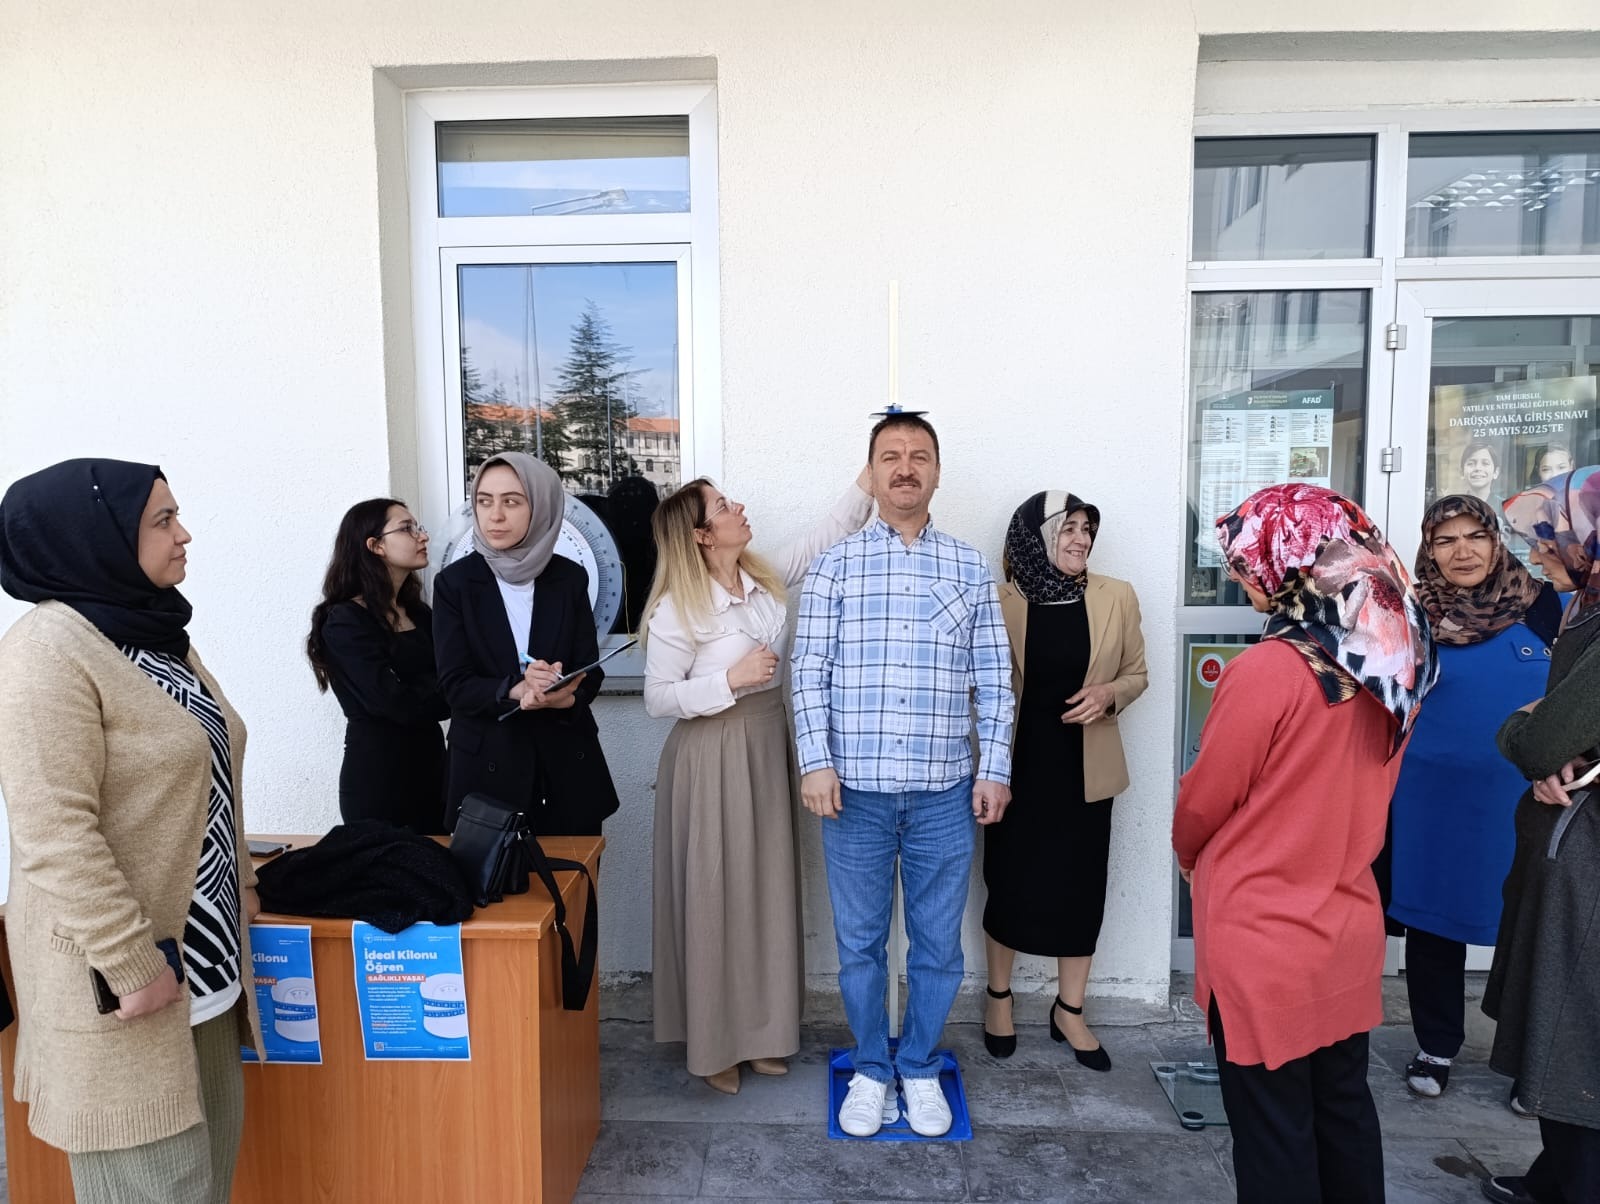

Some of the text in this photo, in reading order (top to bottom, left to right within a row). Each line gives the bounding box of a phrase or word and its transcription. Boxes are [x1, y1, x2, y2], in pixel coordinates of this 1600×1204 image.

[1462, 405, 1485, 413] YATILI
[1486, 404, 1494, 412] VE
[1496, 401, 1532, 411] NİTELİKLİ
[1560, 399, 1575, 408] İÇİN
[1449, 410, 1588, 427] DARÜŞŞAFAKA GİRİŞ SINAVI
[1473, 428, 1486, 438] 25
[1488, 426, 1520, 437] MAYIS
[364, 948, 438, 960] İdeal Kilonu
[365, 960, 404, 973] Öğren
[368, 974, 401, 982] SAĞLIKLI
